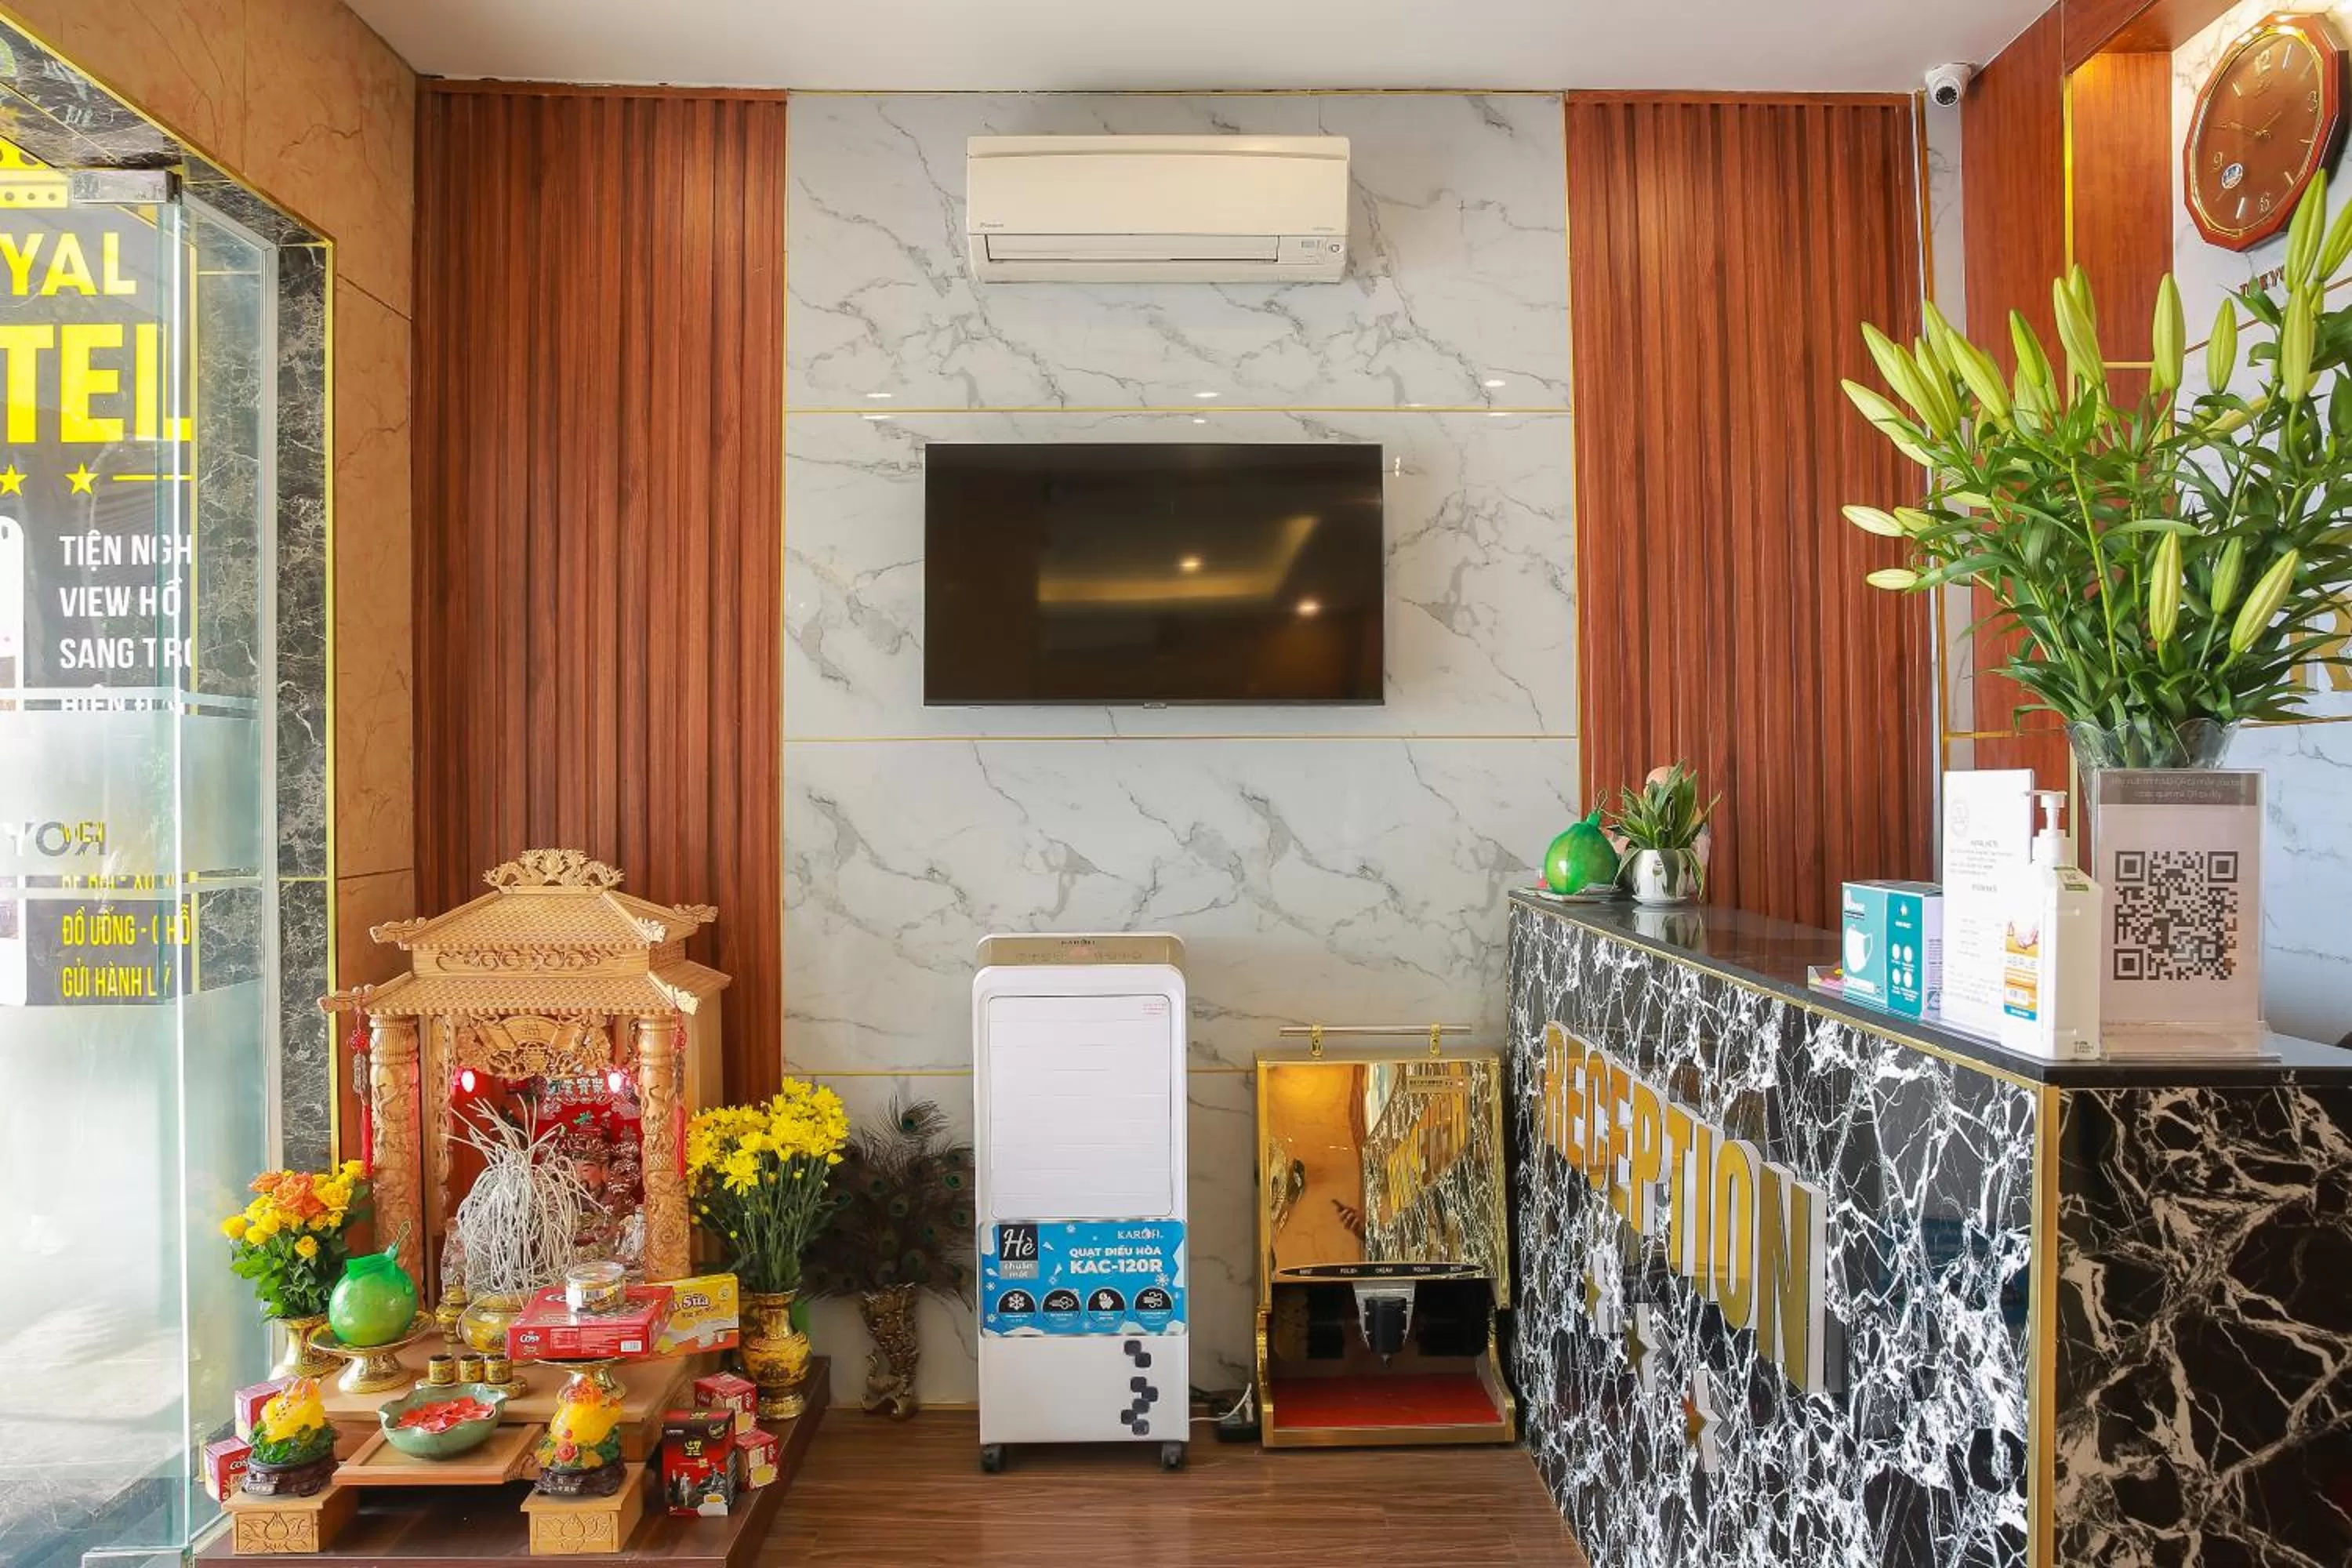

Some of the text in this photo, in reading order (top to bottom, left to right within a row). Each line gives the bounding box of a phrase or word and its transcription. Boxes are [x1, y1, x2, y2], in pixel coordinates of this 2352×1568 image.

[60, 529, 122, 572] TIỆN
[59, 586, 131, 617] VIEW
[60, 637, 134, 669] SANG
[62, 906, 85, 946] ĐỒ
[95, 961, 142, 996] HÀNH
[1543, 1020, 1825, 1394] RECEPTION
[1003, 1228, 1035, 1258] Hè
[1069, 1258, 1163, 1274] KAC-120R
[230, 1459, 248, 1470] Cos
